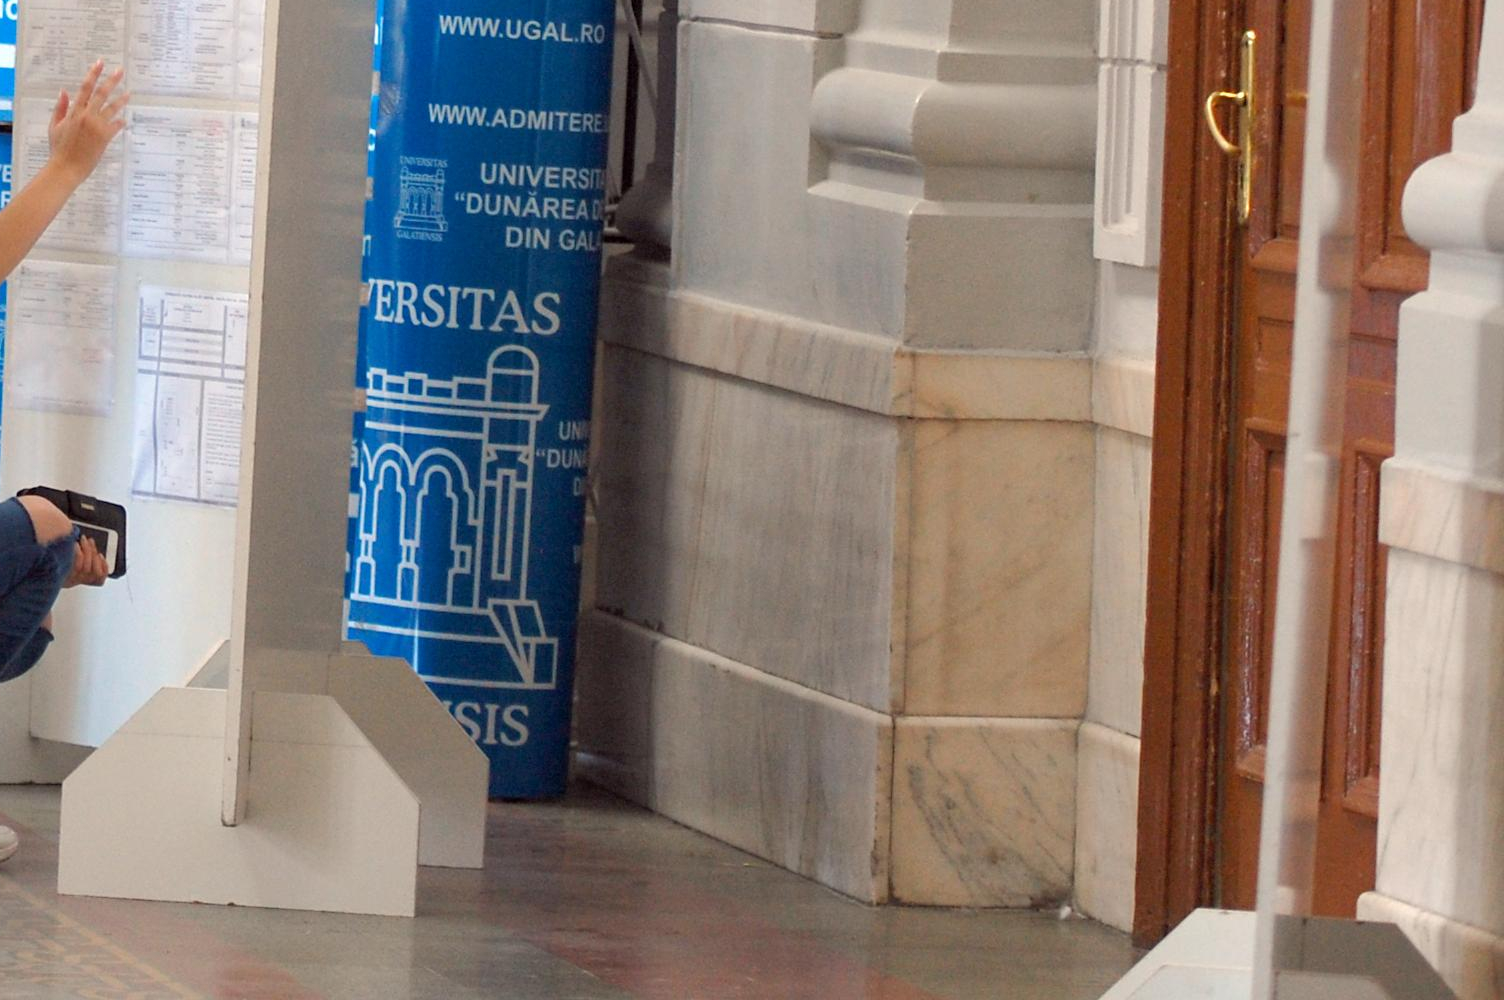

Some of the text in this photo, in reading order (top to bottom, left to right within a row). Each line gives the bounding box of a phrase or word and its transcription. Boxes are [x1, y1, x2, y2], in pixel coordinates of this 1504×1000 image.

[439, 15, 605, 44] WWW.UGAL.RO
[480, 162, 606, 190] UNIVERSIT
[455, 191, 588, 221] “DUNĂREA
[505, 227, 550, 250] DIN
